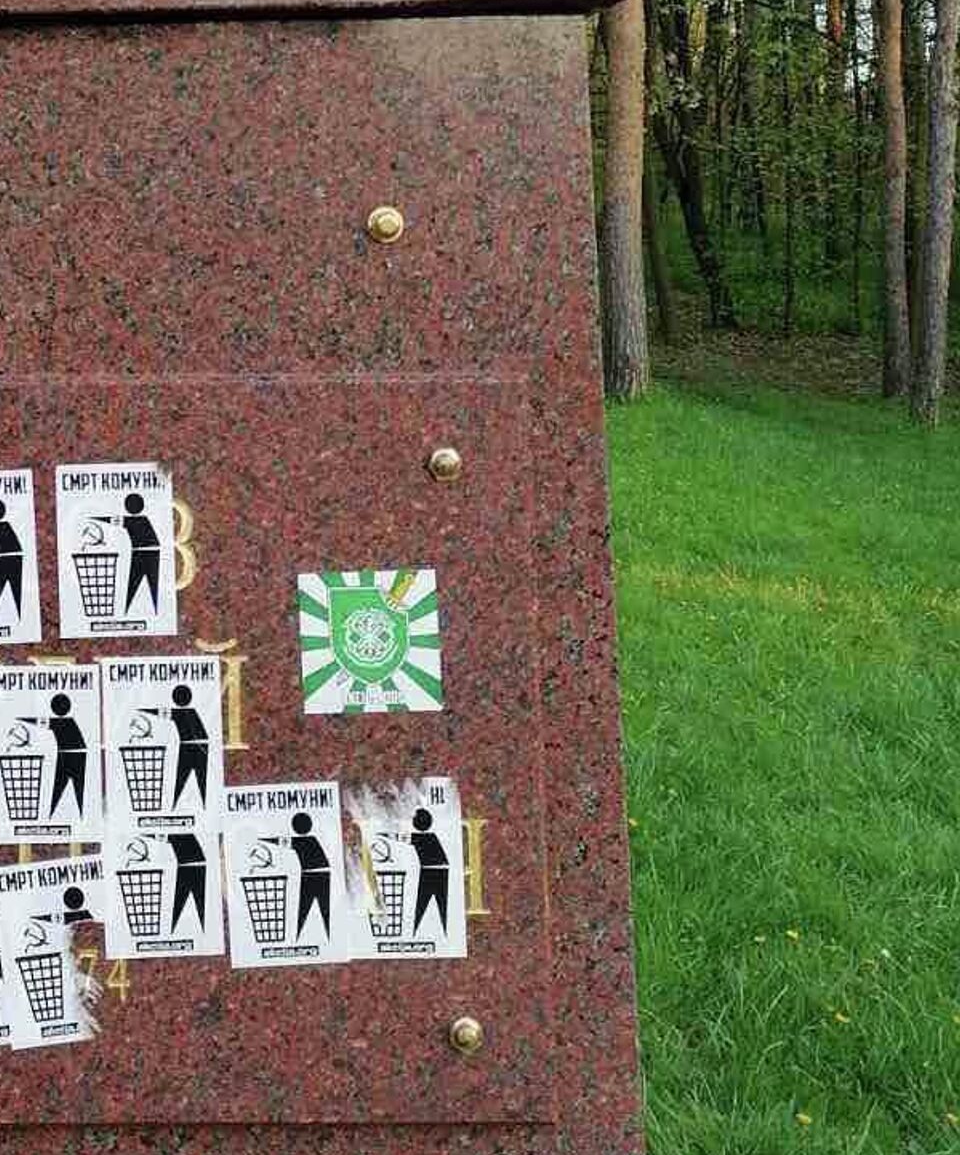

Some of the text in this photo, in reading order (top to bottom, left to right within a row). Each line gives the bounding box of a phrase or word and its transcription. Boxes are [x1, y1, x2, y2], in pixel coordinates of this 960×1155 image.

[62, 473, 97, 491] СМРТ
[27, 671, 93, 690] КОМУНИ!
[109, 662, 214, 682] СМРТ КОМУНИ!
[227, 788, 333, 812] СМРТ КОМУНИ!
[37, 859, 104, 887] КОМУНИ!
